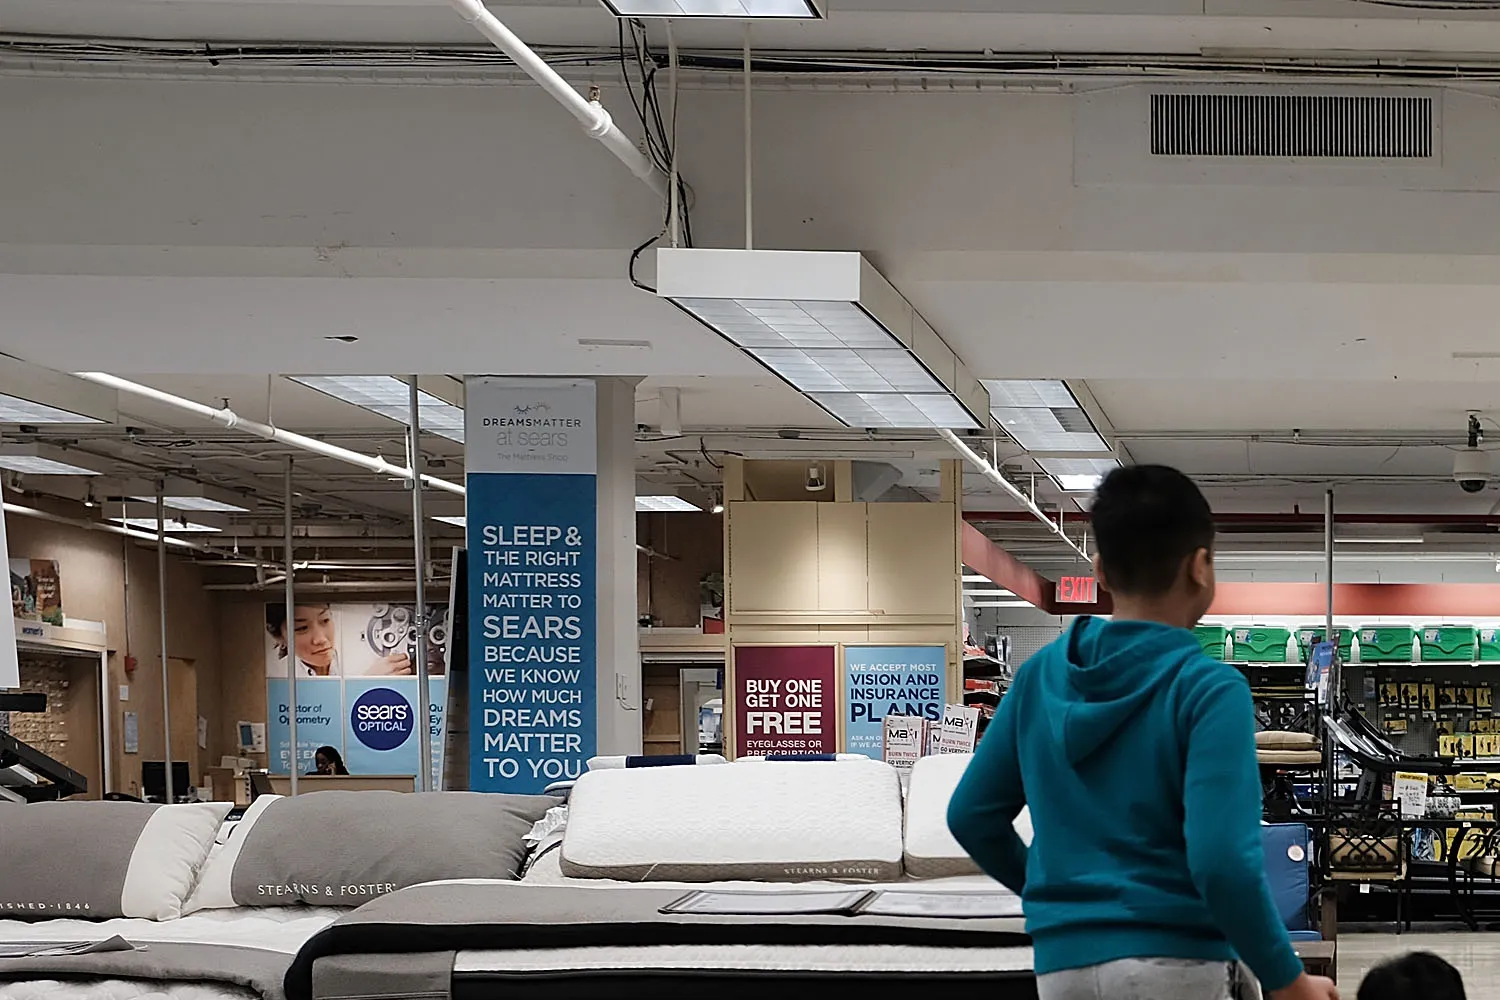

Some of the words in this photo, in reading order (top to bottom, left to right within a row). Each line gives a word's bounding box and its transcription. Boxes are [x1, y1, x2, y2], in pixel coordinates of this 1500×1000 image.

[483, 418, 581, 428] DREAMSMATTER
[497, 428, 512, 446] at
[518, 432, 568, 447] sears
[483, 526, 562, 546] SLEEP
[565, 526, 582, 547] &
[484, 552, 520, 566] THE
[526, 551, 580, 566] RIGHT
[484, 572, 581, 588] MATTRESS
[1060, 576, 1094, 601] EXIT
[484, 594, 552, 608] MATTER
[558, 594, 581, 608] TO
[483, 615, 582, 639] SEARS
[485, 647, 581, 663] BECAUSE
[850, 664, 867, 672] WE
[870, 664, 906, 672] ACCEPT
[910, 664, 936, 672] MOST
[485, 669, 516, 683] WE
[522, 669, 580, 683] KNOW
[851, 674, 901, 686] VISION
[905, 674, 939, 686] AND
[746, 680, 781, 693] BUY
[786, 680, 822, 693] ONE
[484, 689, 526, 703] HOW
[533, 689, 582, 703] MUCH
[746, 694, 780, 708] GET
[786, 694, 822, 708] ONE
[851, 688, 939, 700] INSURANCE
[279, 704, 311, 713] Dotor
[313, 704, 322, 712] of
[358, 704, 407, 720] sears
[851, 703, 940, 723] PLANS
[279, 715, 331, 726] Opometry
[484, 710, 582, 727] DREAMS
[747, 712, 822, 735] FREE
[359, 721, 406, 732] OPTICAL
[484, 734, 581, 752] MATTER
[747, 740, 805, 748] EYEGLASSES
[808, 740, 822, 748] OR
[484, 758, 518, 778] TO
[527, 758, 582, 778] YOU
[258, 883, 319, 896] STEARNS
[325, 886, 334, 896] &
[340, 883, 396, 896] FOSTER
